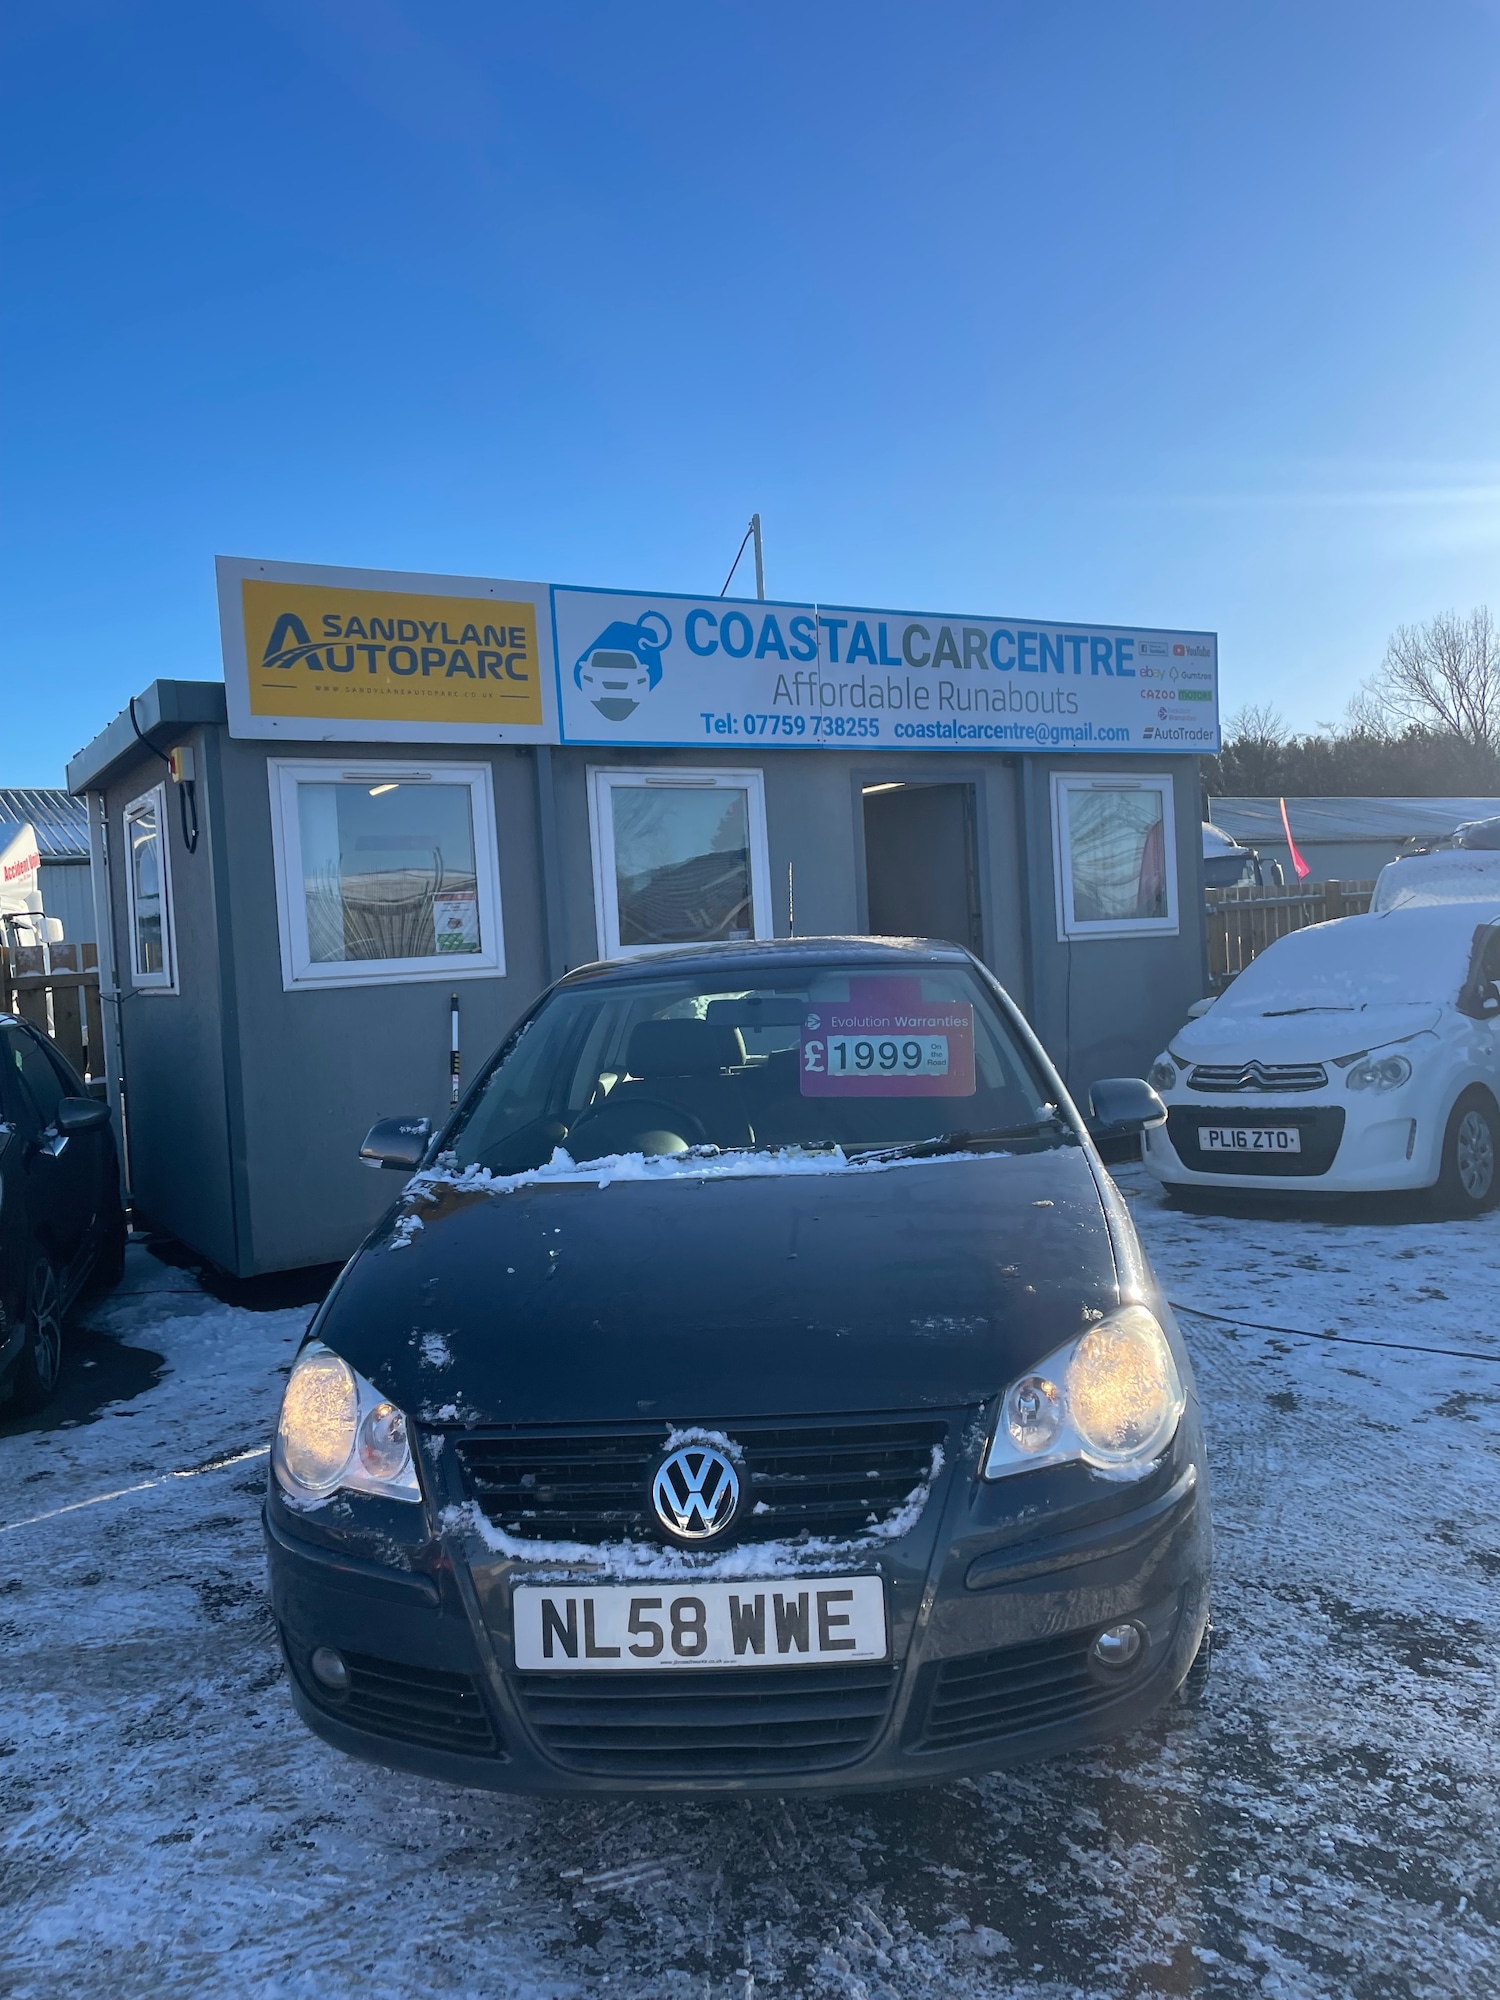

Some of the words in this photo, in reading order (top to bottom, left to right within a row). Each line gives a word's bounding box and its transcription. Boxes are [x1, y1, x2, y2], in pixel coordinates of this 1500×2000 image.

[322, 614, 527, 650] SANDYLANE
[261, 612, 529, 682] AUTOPARC
[1186, 646, 1211, 657] YouTube
[1140, 665, 1165, 680] ebay
[1181, 671, 1212, 681] Gumtree
[773, 671, 930, 710] Affordable
[938, 680, 1079, 715] Runabouts
[1140, 689, 1176, 700] CAZOO
[701, 713, 739, 735] Tel:
[743, 715, 806, 737] 07759
[810, 717, 880, 738] 738255
[894, 719, 1130, 745] coastalcarcentre@gmail.com
[1154, 728, 1214, 740] AutoTrader
[4, 857, 29, 882] Accident
[831, 1016, 890, 1028] Evolution
[894, 1016, 969, 1028] Warranties
[1209, 1130, 1248, 1148] PL16
[1252, 1130, 1288, 1149] ZTO
[541, 1596, 708, 1659] NL58
[728, 1589, 857, 1655] WWE
